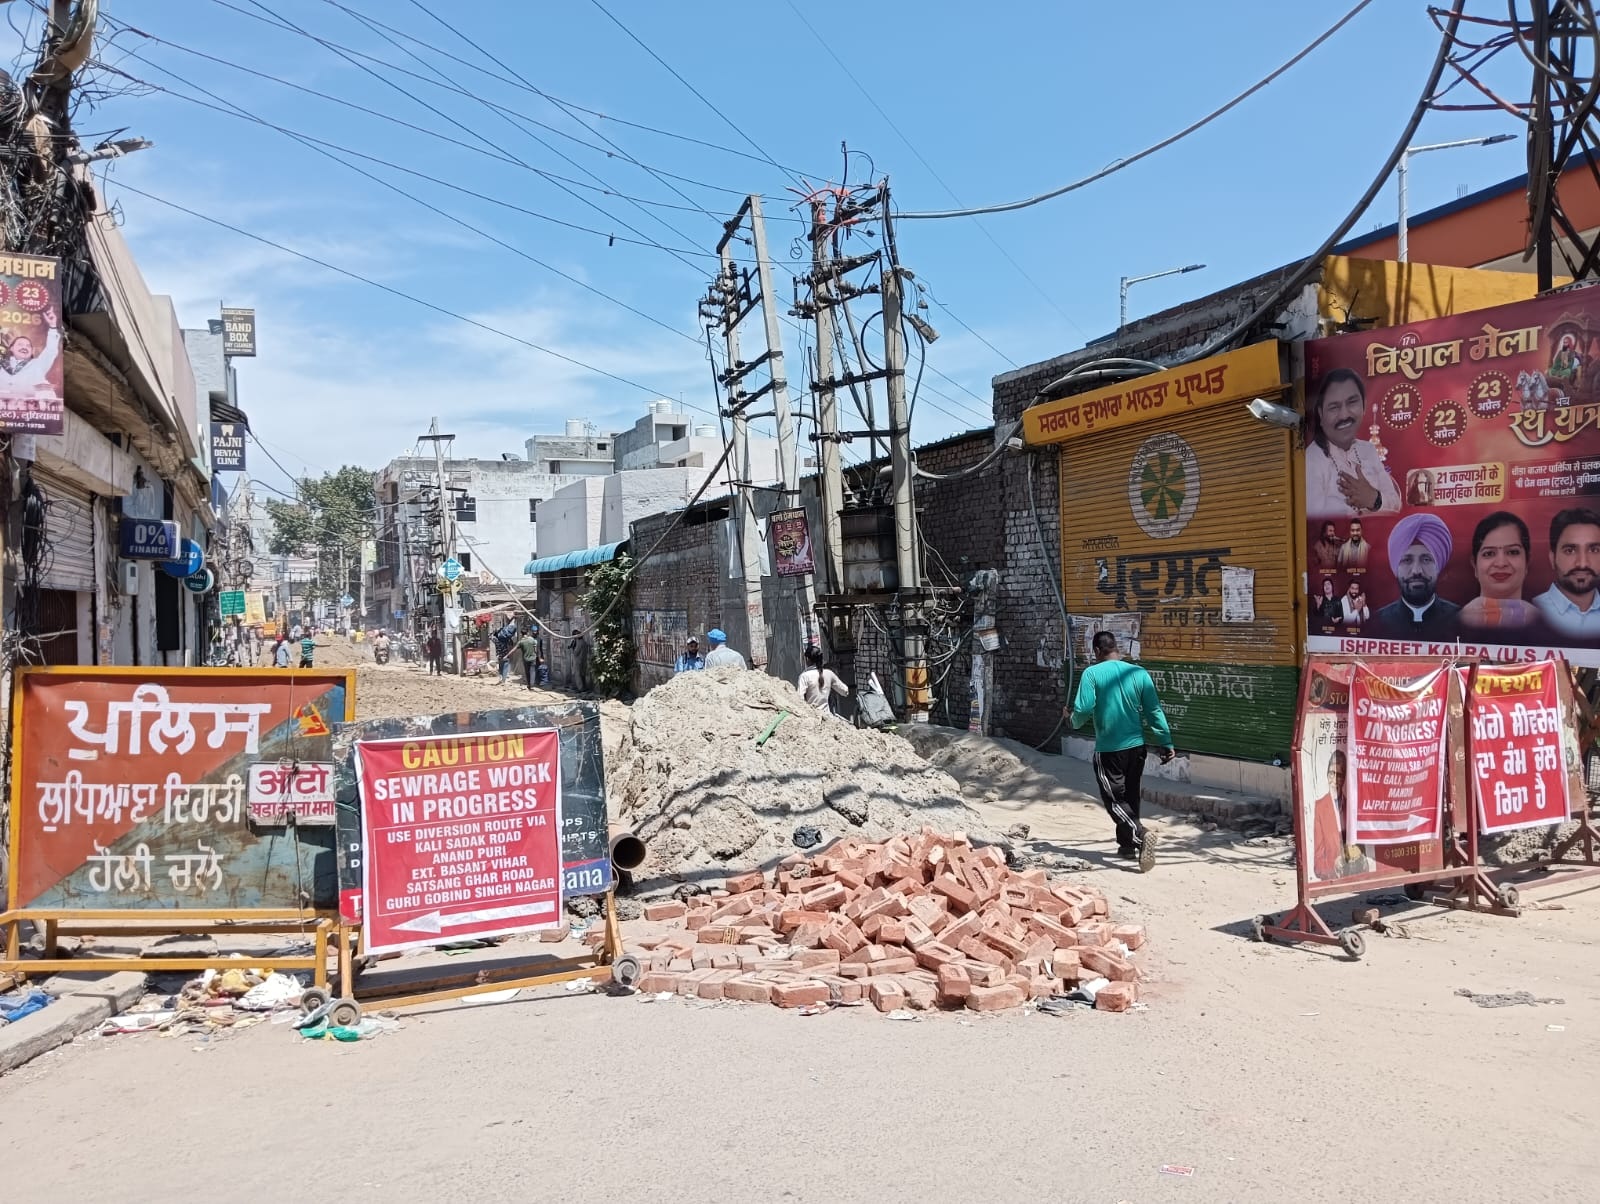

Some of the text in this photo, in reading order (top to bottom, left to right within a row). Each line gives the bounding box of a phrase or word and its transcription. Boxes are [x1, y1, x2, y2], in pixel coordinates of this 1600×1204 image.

[23, 287, 40, 298] 23
[2, 311, 42, 325] 2026
[225, 322, 251, 332] BAND
[230, 333, 248, 342] BOX
[1366, 337, 1464, 380] विशाल
[1469, 323, 1543, 361] मेला
[1478, 380, 1501, 398] 23
[1393, 393, 1410, 409] 21
[1038, 405, 1081, 433] ਸਰਕਾਰ
[1435, 409, 1456, 426] 22
[1508, 408, 1554, 446] रथ
[213, 437, 242, 447] PAJNI
[214, 449, 242, 457] DENTAL
[217, 457, 239, 465] CLINIC
[1437, 464, 1499, 484] 21 कन्याओं के
[1434, 482, 1500, 503] सामूहिक विवाह
[134, 524, 166, 545] 0%
[129, 545, 169, 554] FINANCE
[1340, 639, 1422, 656] ISHPREET
[1475, 671, 1542, 694] ਸਾਵਧਾਨ
[1329, 692, 1349, 705] STO
[64, 683, 272, 760] ਪੁਲਿਸ
[1364, 722, 1383, 740] IN
[1473, 704, 1505, 740] ਅੱਗੇ
[402, 733, 525, 769] CAUTION
[1476, 738, 1556, 778] ਦਾ ਕੰਮ ਚੱਲ
[256, 763, 329, 795] ऑटो
[374, 762, 551, 800] SEWRAGE WORK
[164, 771, 246, 823] ਦਿਹਾਤੀ
[1494, 773, 1546, 816] ਰਿਹਾ ਹੈ
[392, 788, 537, 824] IN PROGRESS
[387, 814, 546, 844] USE DIVERSION ROUTE VIA
[415, 830, 521, 854] KALI SADAK ROAD
[1405, 845, 1417, 857] 313
[164, 839, 224, 892] ਚਲੋ
[432, 846, 507, 864] ANAND PURI
[412, 856, 528, 880] EXT. BASANT VIHAR
[406, 868, 534, 894] SATSANG GHAR ROAD
[386, 878, 555, 910] GURU GOBIND SINGH NAGAR
